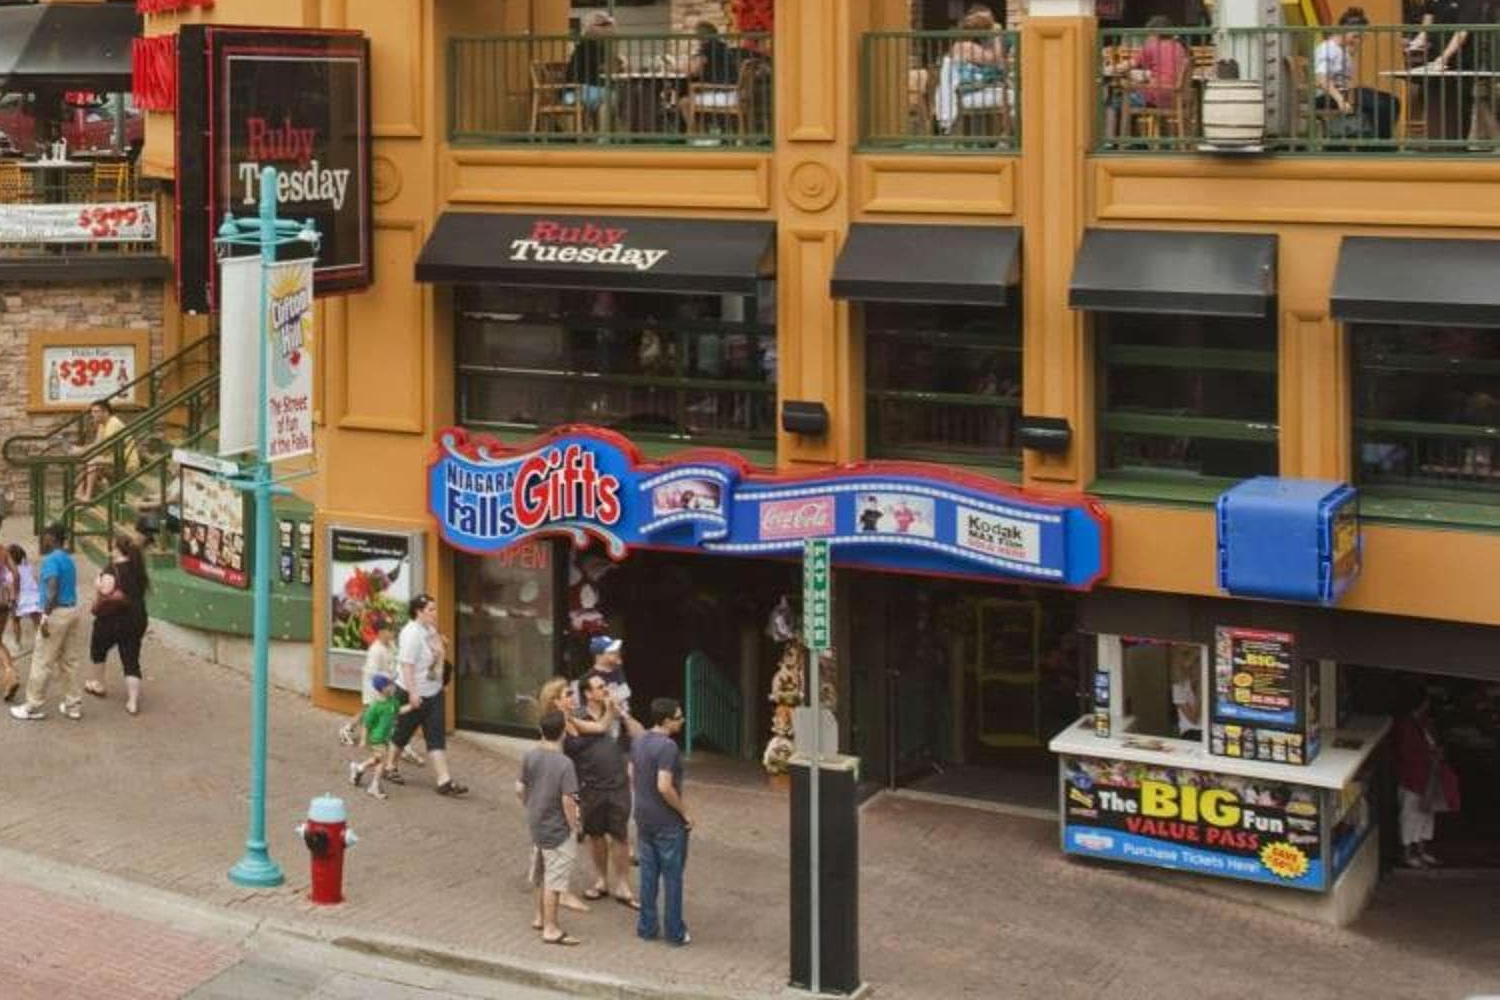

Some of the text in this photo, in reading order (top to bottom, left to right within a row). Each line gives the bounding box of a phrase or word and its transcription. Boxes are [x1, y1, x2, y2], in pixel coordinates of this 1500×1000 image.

[247, 117, 316, 170] Ruby
[239, 160, 350, 210] Tesday
[531, 221, 628, 247] Ruby
[510, 240, 668, 271] Tuesday
[447, 463, 513, 493] NIAGARA
[512, 444, 620, 529] Gifts
[447, 487, 517, 538] Falls
[968, 514, 1022, 540] Kodak
[1099, 791, 1138, 814] The
[1140, 780, 1241, 827] BIG
[1243, 812, 1284, 834] Fun
[1126, 817, 1199, 842] VALUE
[1206, 827, 1260, 850] PASS
[1123, 842, 1178, 862] Purchase
[1183, 851, 1226, 870] Tickets
